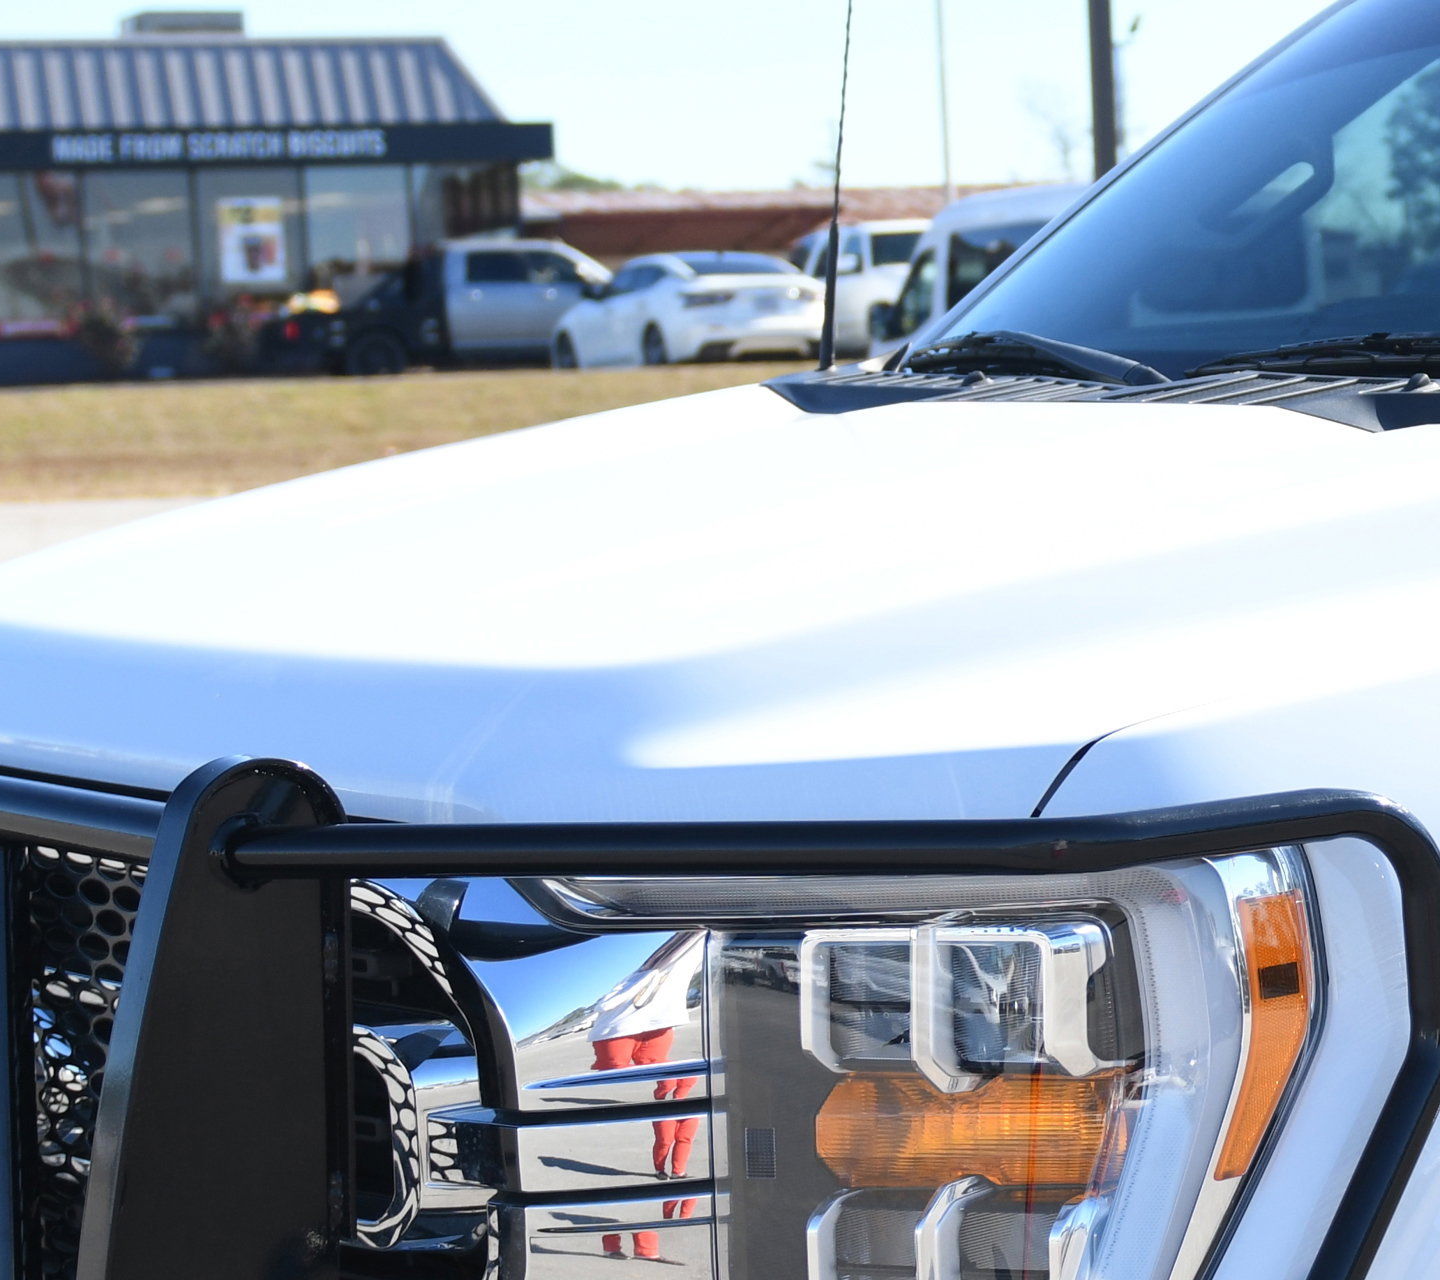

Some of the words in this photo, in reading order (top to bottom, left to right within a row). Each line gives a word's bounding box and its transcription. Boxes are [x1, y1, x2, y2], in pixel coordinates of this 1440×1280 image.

[52, 134, 113, 162] MADE
[119, 133, 182, 160] FROM
[187, 131, 282, 159] SCRATCH
[287, 128, 386, 158] BISCUITS
